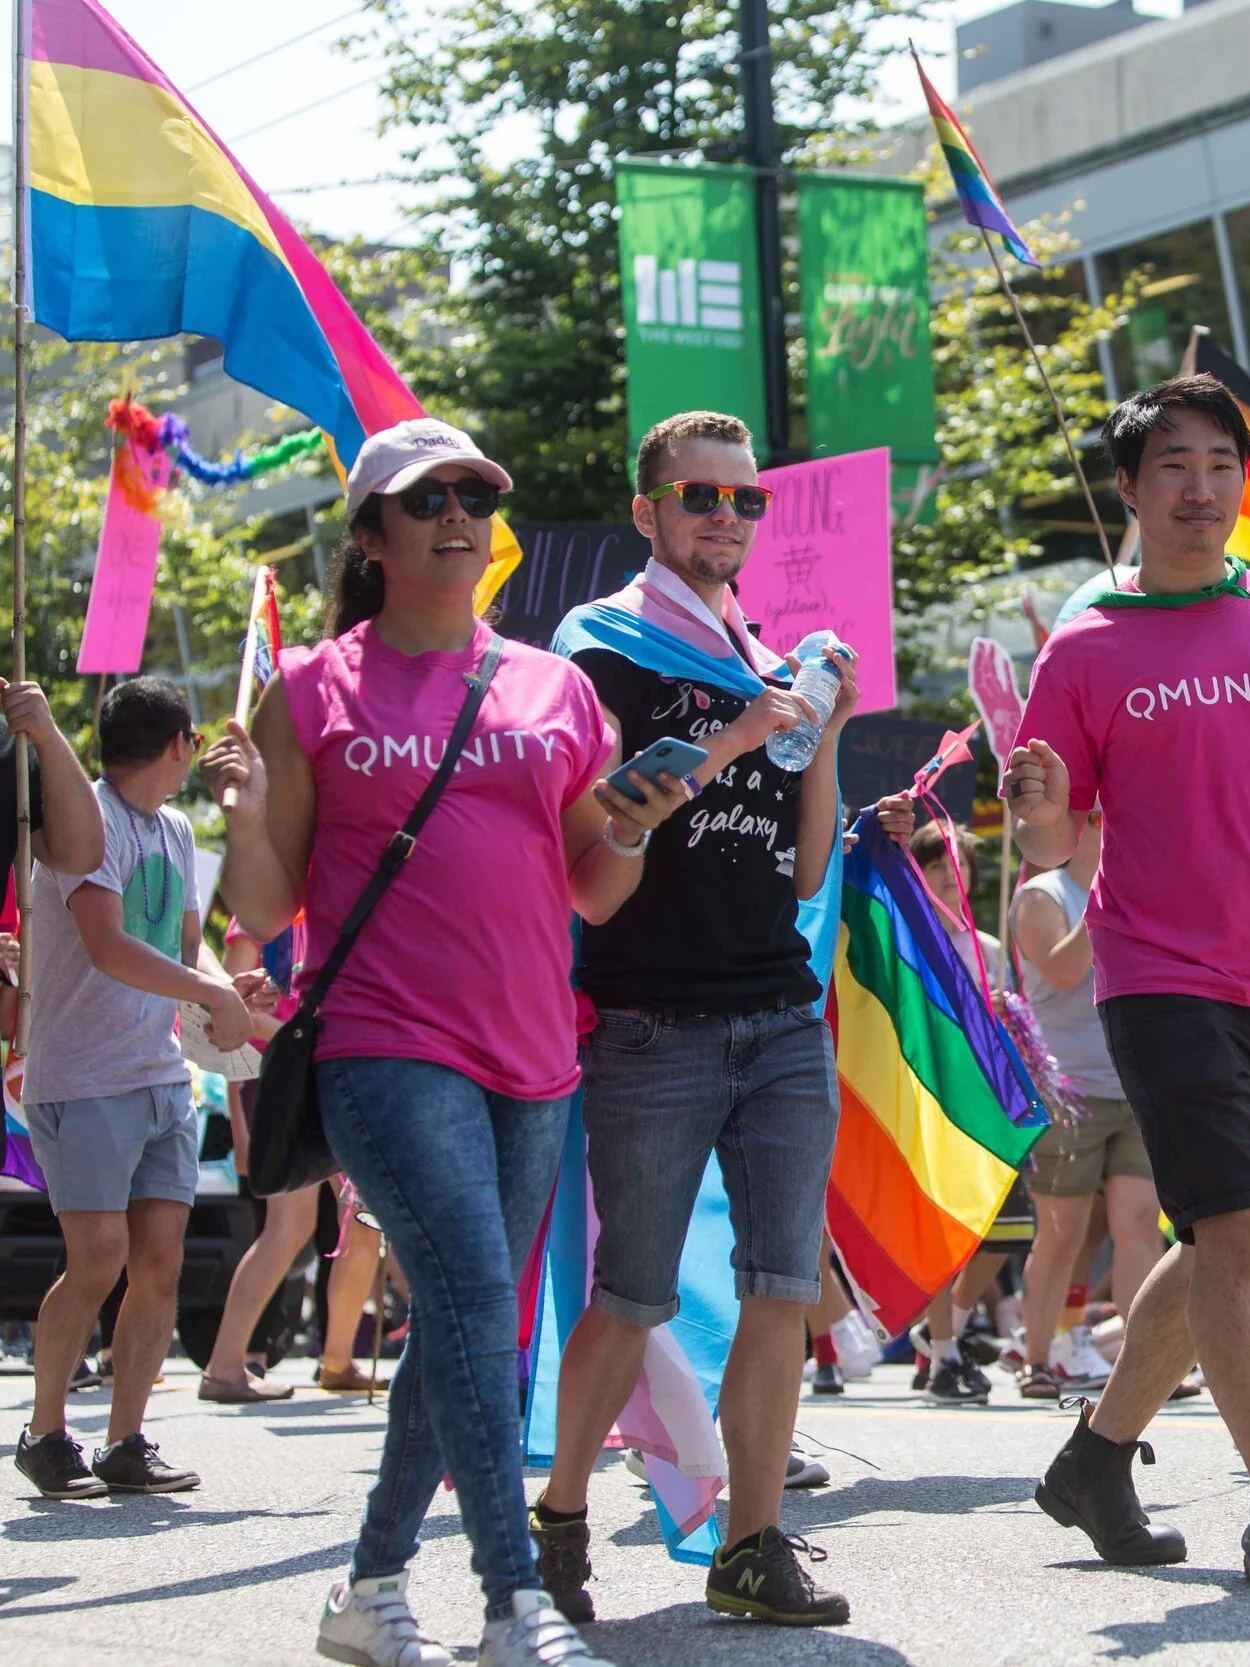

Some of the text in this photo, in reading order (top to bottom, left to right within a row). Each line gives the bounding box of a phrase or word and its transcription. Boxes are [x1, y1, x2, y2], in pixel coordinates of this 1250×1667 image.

[413, 434, 461, 450] Daddy
[345, 730, 555, 777] QMUNITY
[747, 770, 762, 791] a
[687, 803, 778, 851] galaxy
